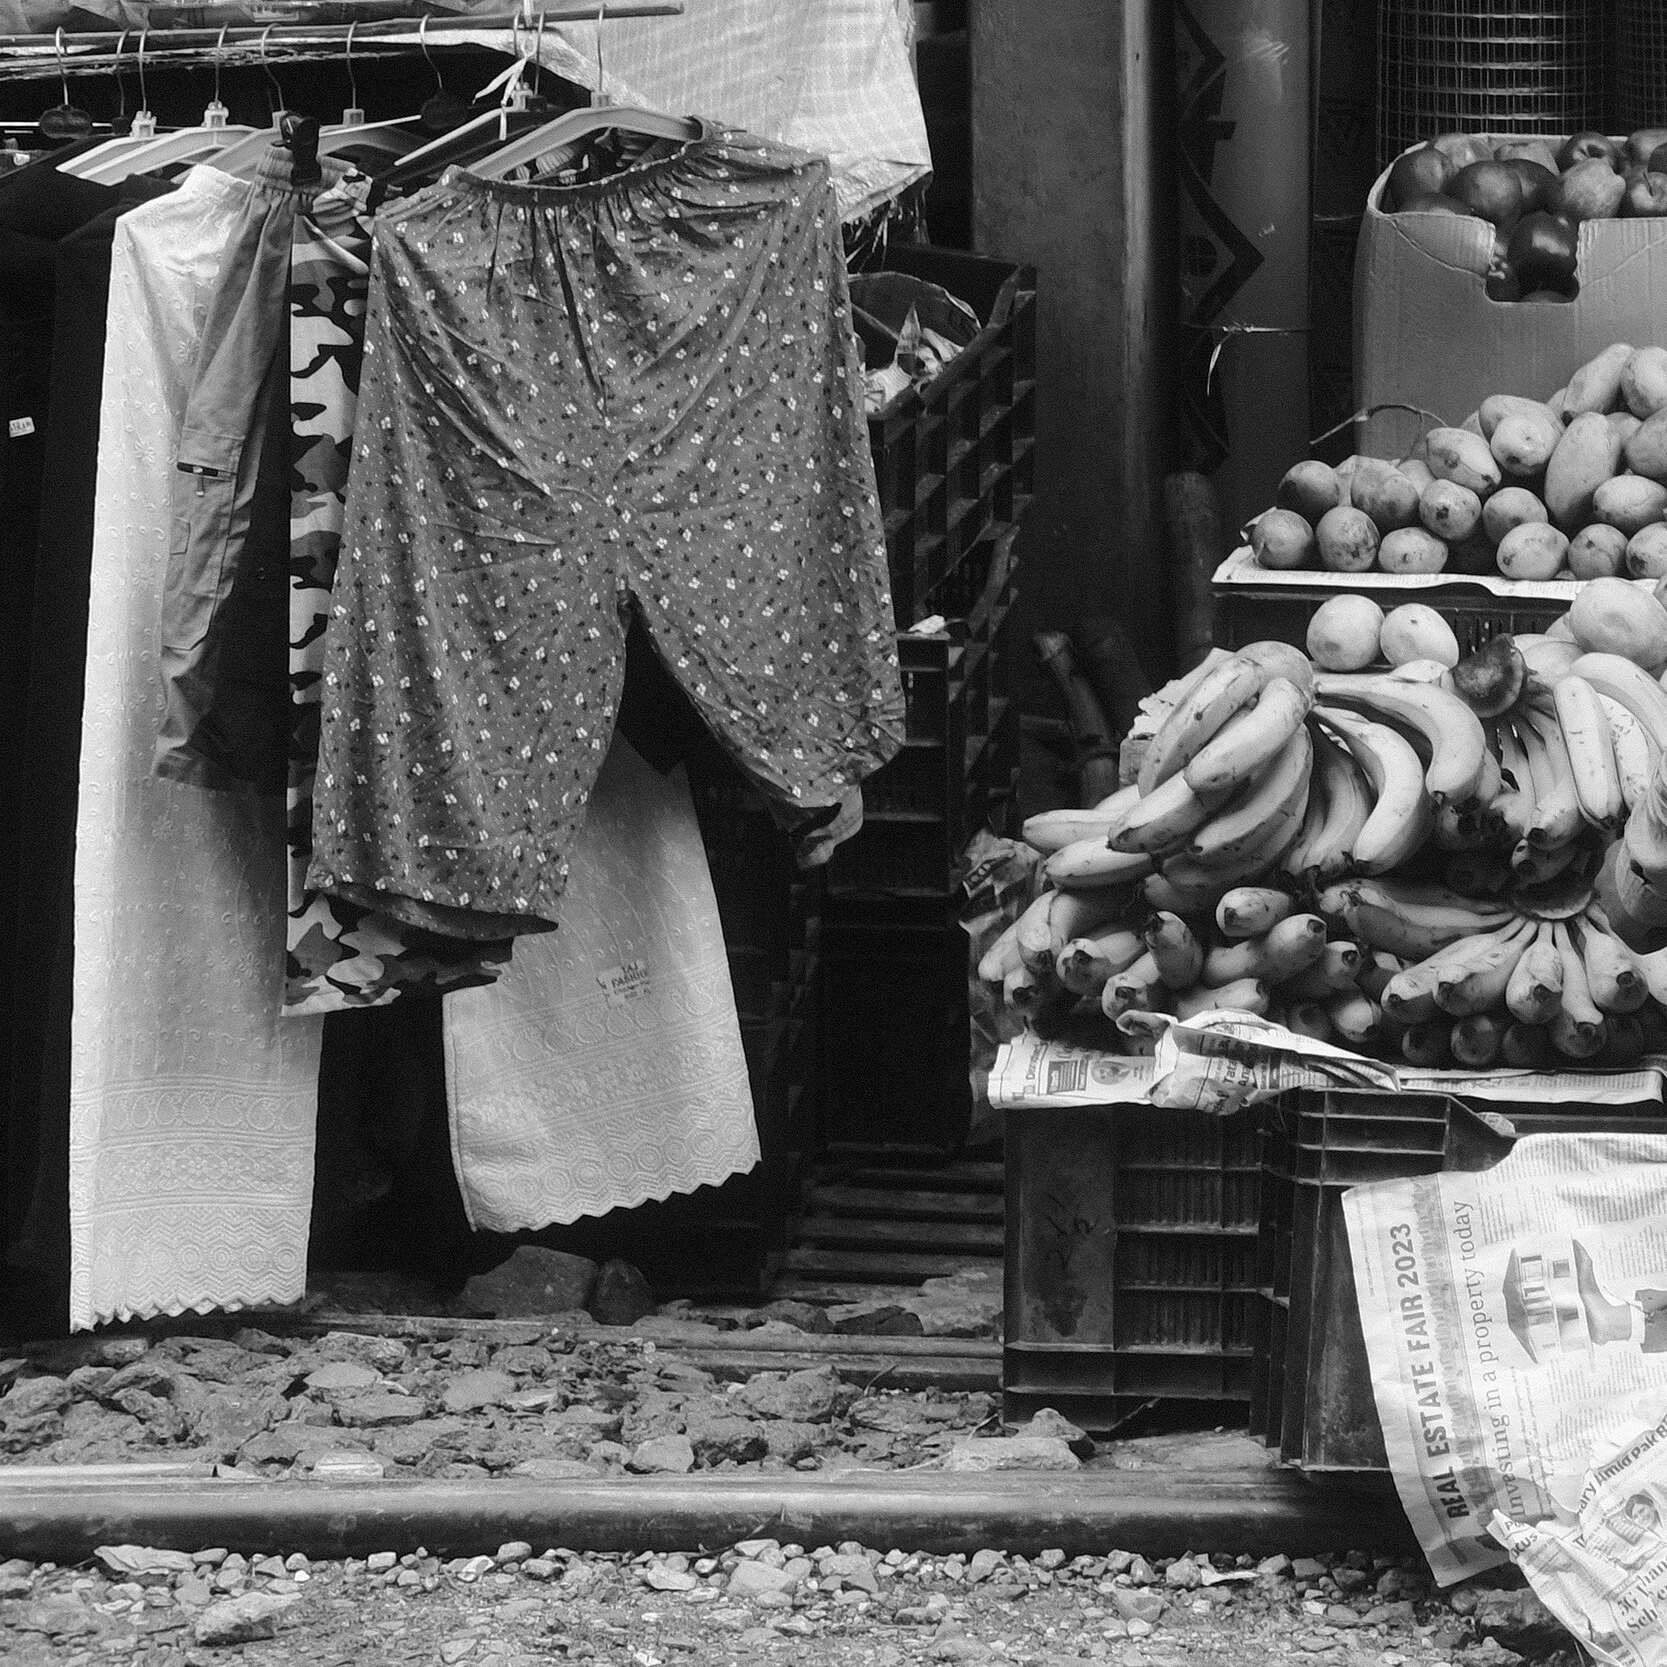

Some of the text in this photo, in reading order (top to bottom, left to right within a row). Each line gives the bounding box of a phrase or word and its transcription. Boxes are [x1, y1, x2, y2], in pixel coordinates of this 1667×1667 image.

[1453, 1201, 1475, 1262] today
[1465, 1268, 1499, 1365] property
[1389, 1223, 1470, 1518] REAL ESTATE FAIR 2023
[1482, 1370, 1497, 1382] a
[1483, 1389, 1502, 1412] in
[1490, 1414, 1526, 1518] Investing
